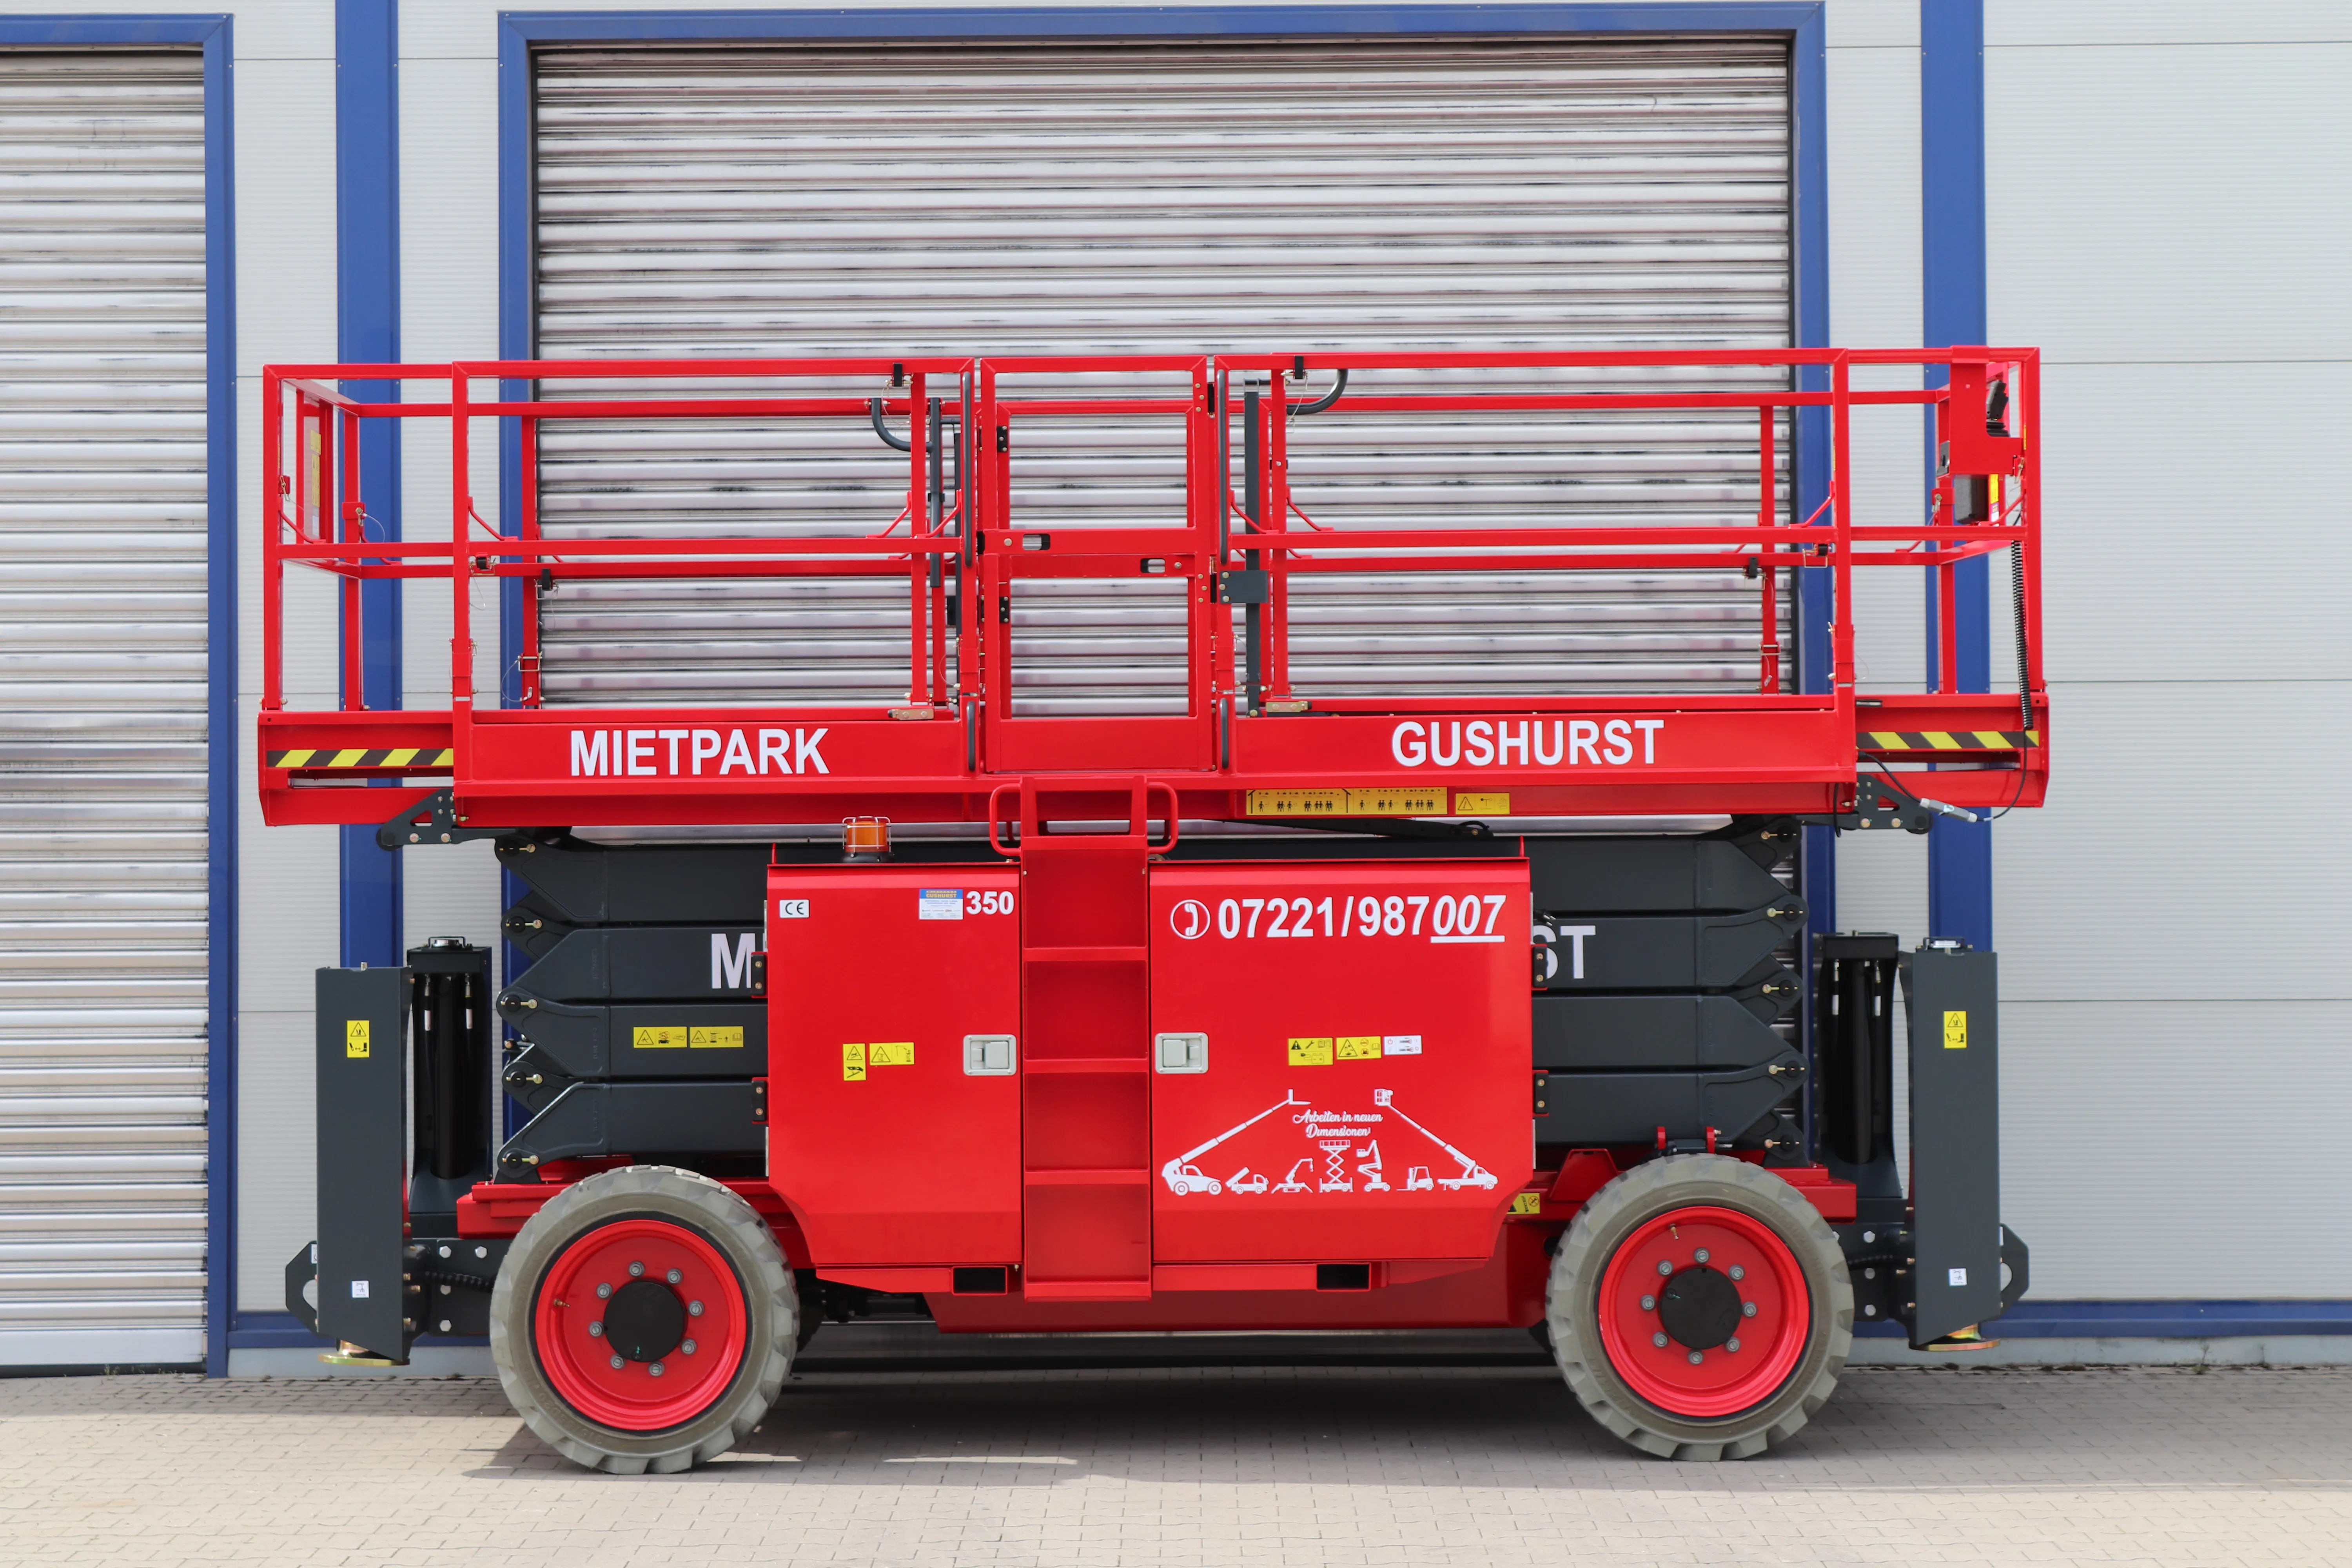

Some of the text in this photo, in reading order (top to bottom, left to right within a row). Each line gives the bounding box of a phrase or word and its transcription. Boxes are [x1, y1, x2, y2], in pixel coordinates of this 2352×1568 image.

[570, 728, 830, 776] MIETPARK
[1392, 719, 1664, 767] GUSHURST
[786, 902, 804, 915] CE
[966, 891, 1014, 915] 350
[1218, 895, 1507, 939] 07221/987007
[1292, 1109, 1384, 1123] Arbeiten in neuen
